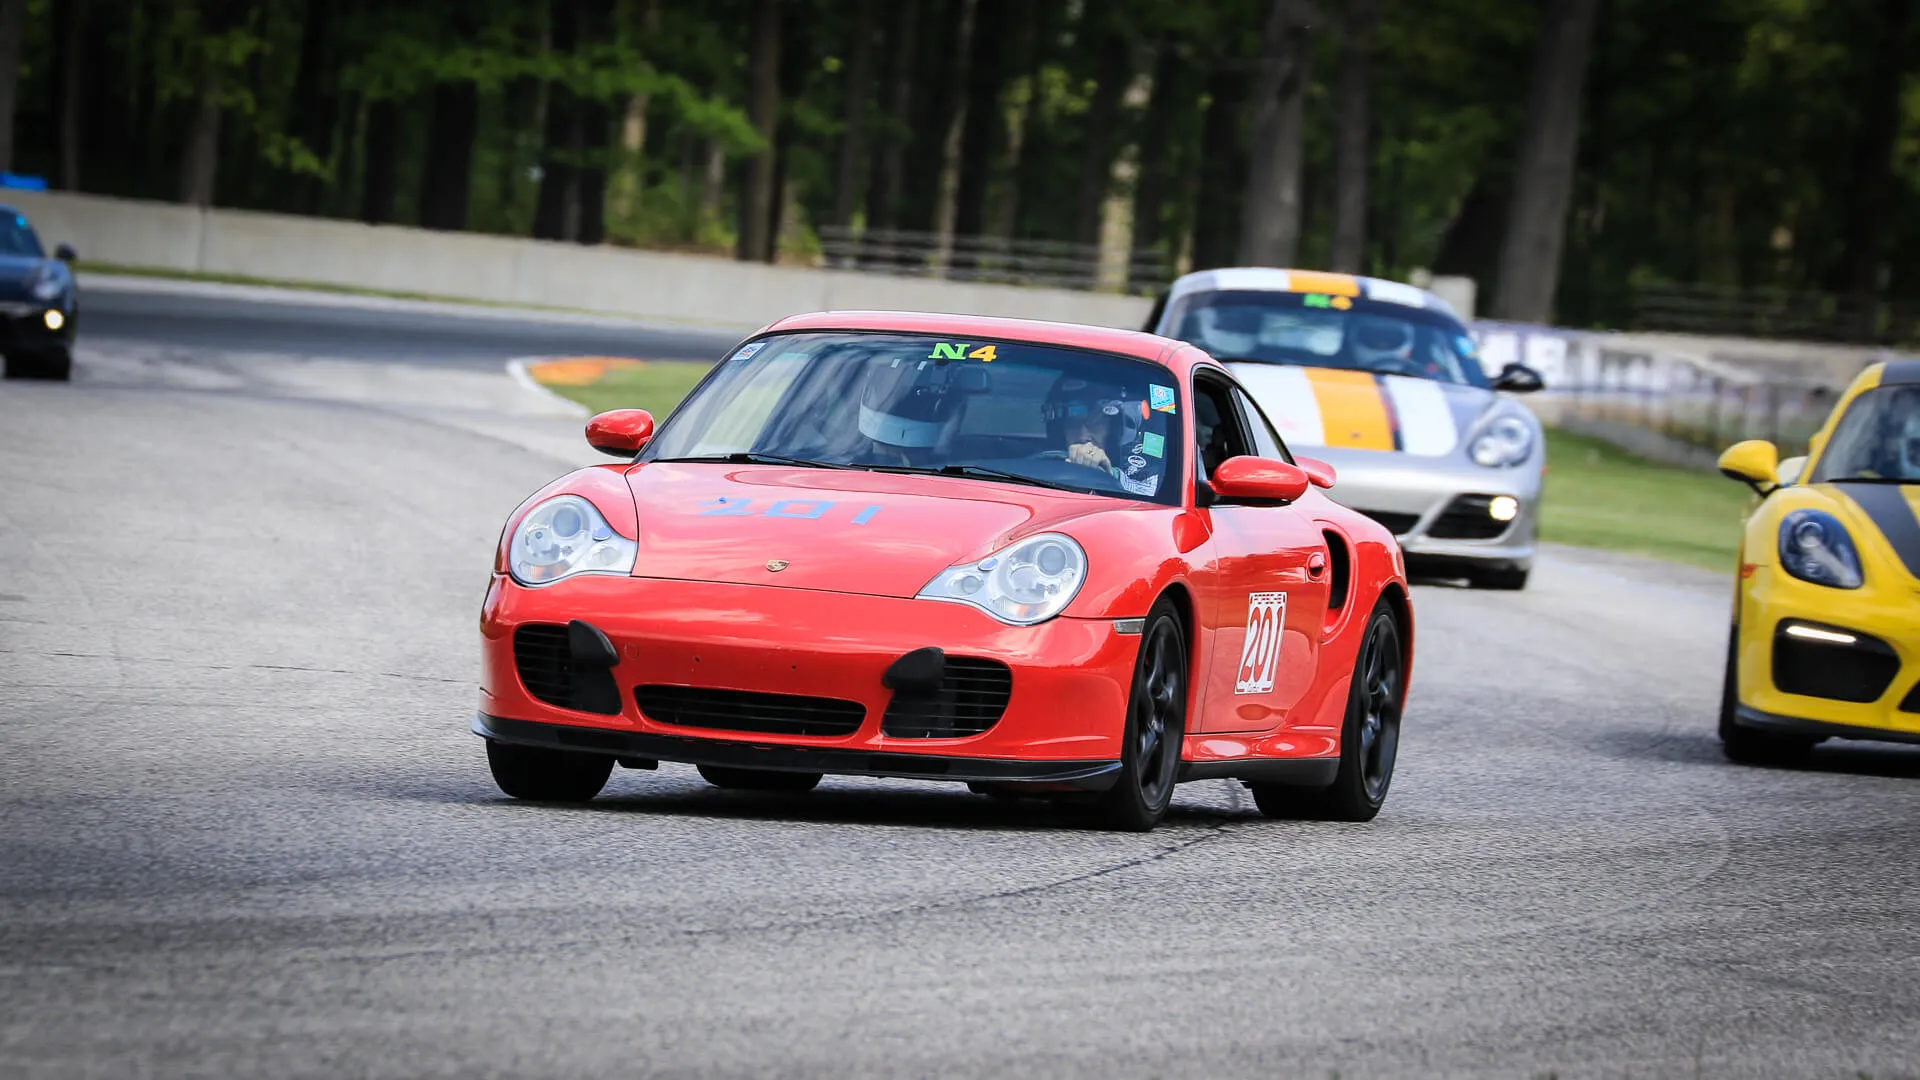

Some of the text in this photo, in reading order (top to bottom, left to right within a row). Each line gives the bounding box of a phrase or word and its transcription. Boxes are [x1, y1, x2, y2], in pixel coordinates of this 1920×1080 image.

[927, 342, 998, 362] N4
[697, 497, 884, 525] 201
[1239, 606, 1283, 683] 201
